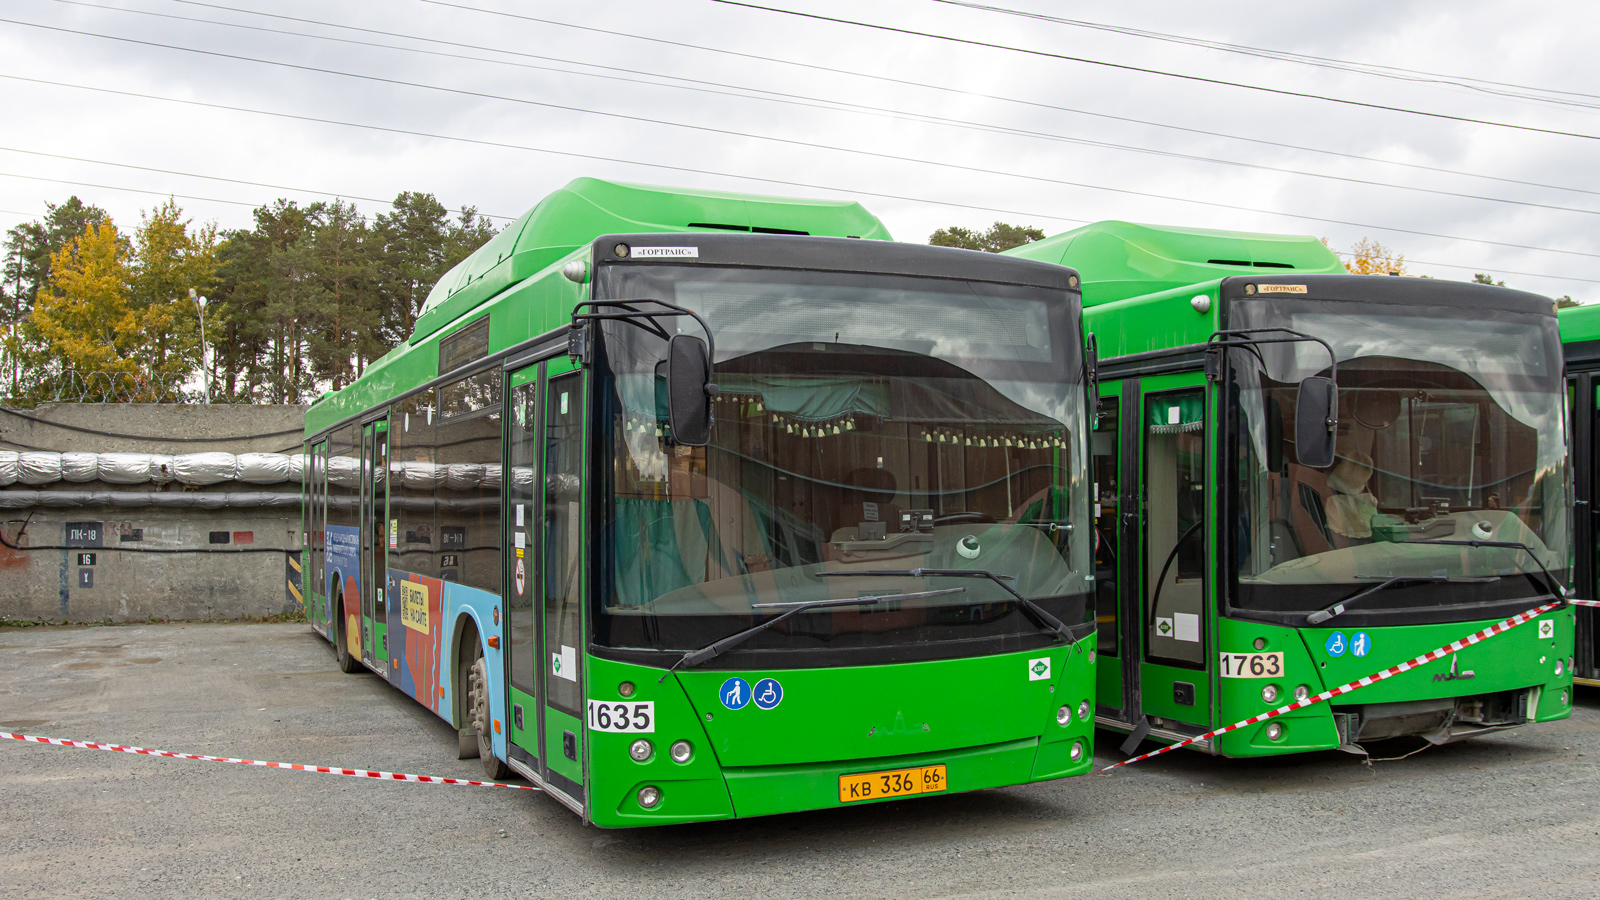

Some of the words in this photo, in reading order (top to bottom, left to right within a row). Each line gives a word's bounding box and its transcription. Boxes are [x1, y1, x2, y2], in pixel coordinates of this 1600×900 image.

[638, 248, 692, 256] «ГОРТРАНС»
[83, 553, 91, 565] 16
[410, 588, 424, 606] БИЛЕТЫ
[416, 608, 427, 627] САЙТЕ
[1221, 654, 1280, 676] 1763
[588, 701, 650, 731] 1635
[881, 773, 913, 794] 336
[923, 769, 940, 783] 66
